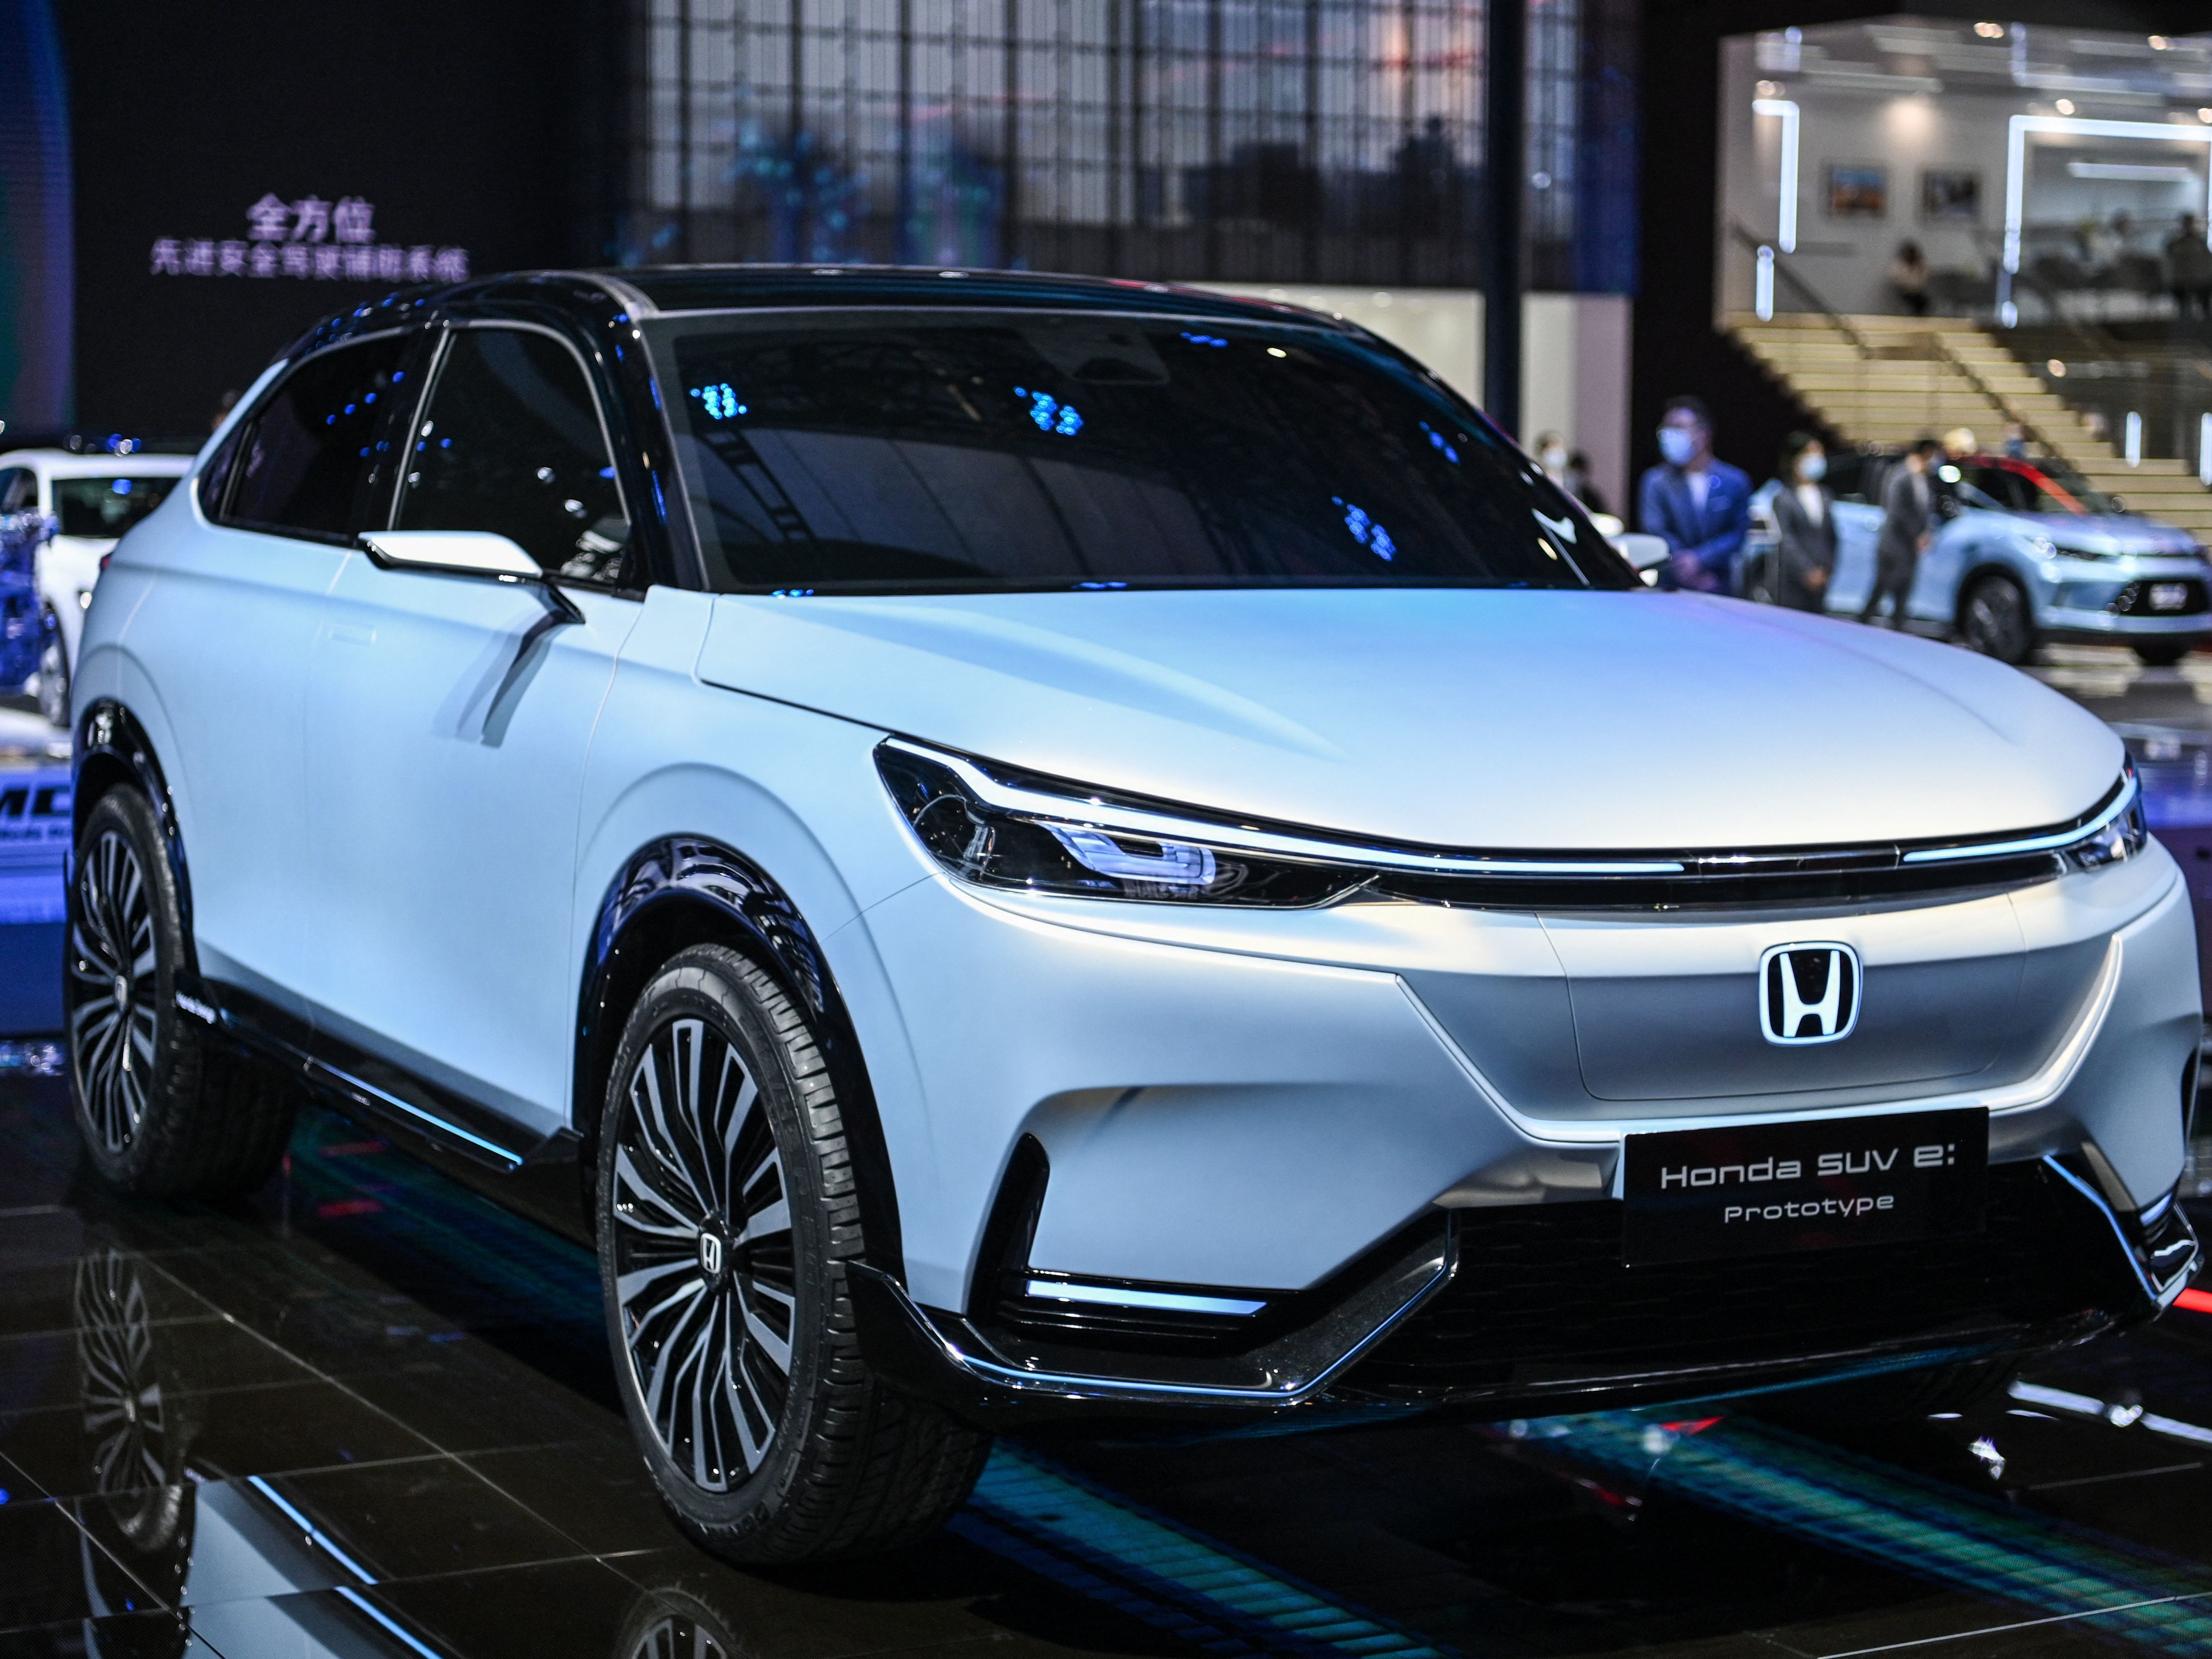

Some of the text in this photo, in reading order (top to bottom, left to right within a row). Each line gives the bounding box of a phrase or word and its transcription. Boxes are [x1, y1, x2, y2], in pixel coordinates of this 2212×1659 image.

[247, 193, 375, 244] 全方位
[1661, 1144, 1955, 1189] Honda SUV e:
[1724, 1195, 1894, 1223] Prototype
